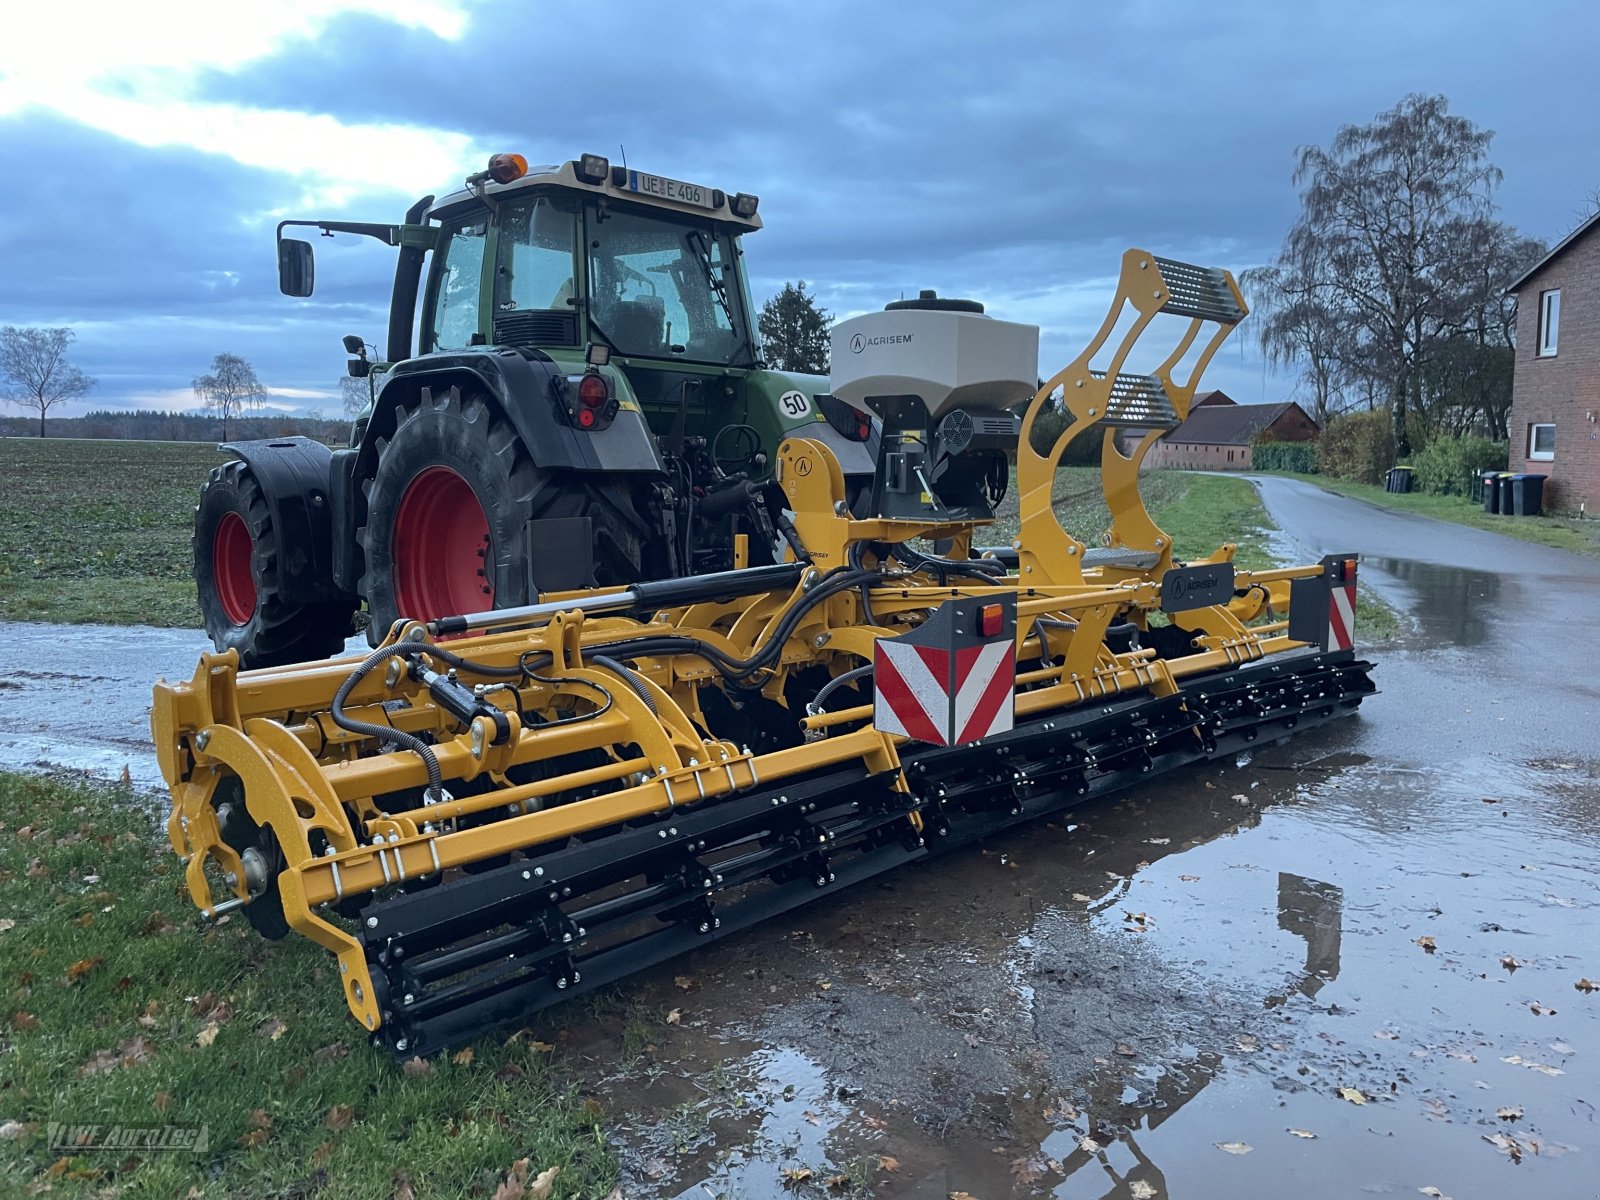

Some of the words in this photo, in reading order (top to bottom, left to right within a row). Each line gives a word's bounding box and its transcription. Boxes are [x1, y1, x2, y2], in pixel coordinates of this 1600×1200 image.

[642, 176, 659, 193] UE
[667, 182, 675, 197] E
[678, 185, 700, 202] 406
[867, 334, 912, 346] AGRISEM
[783, 394, 807, 415] 50
